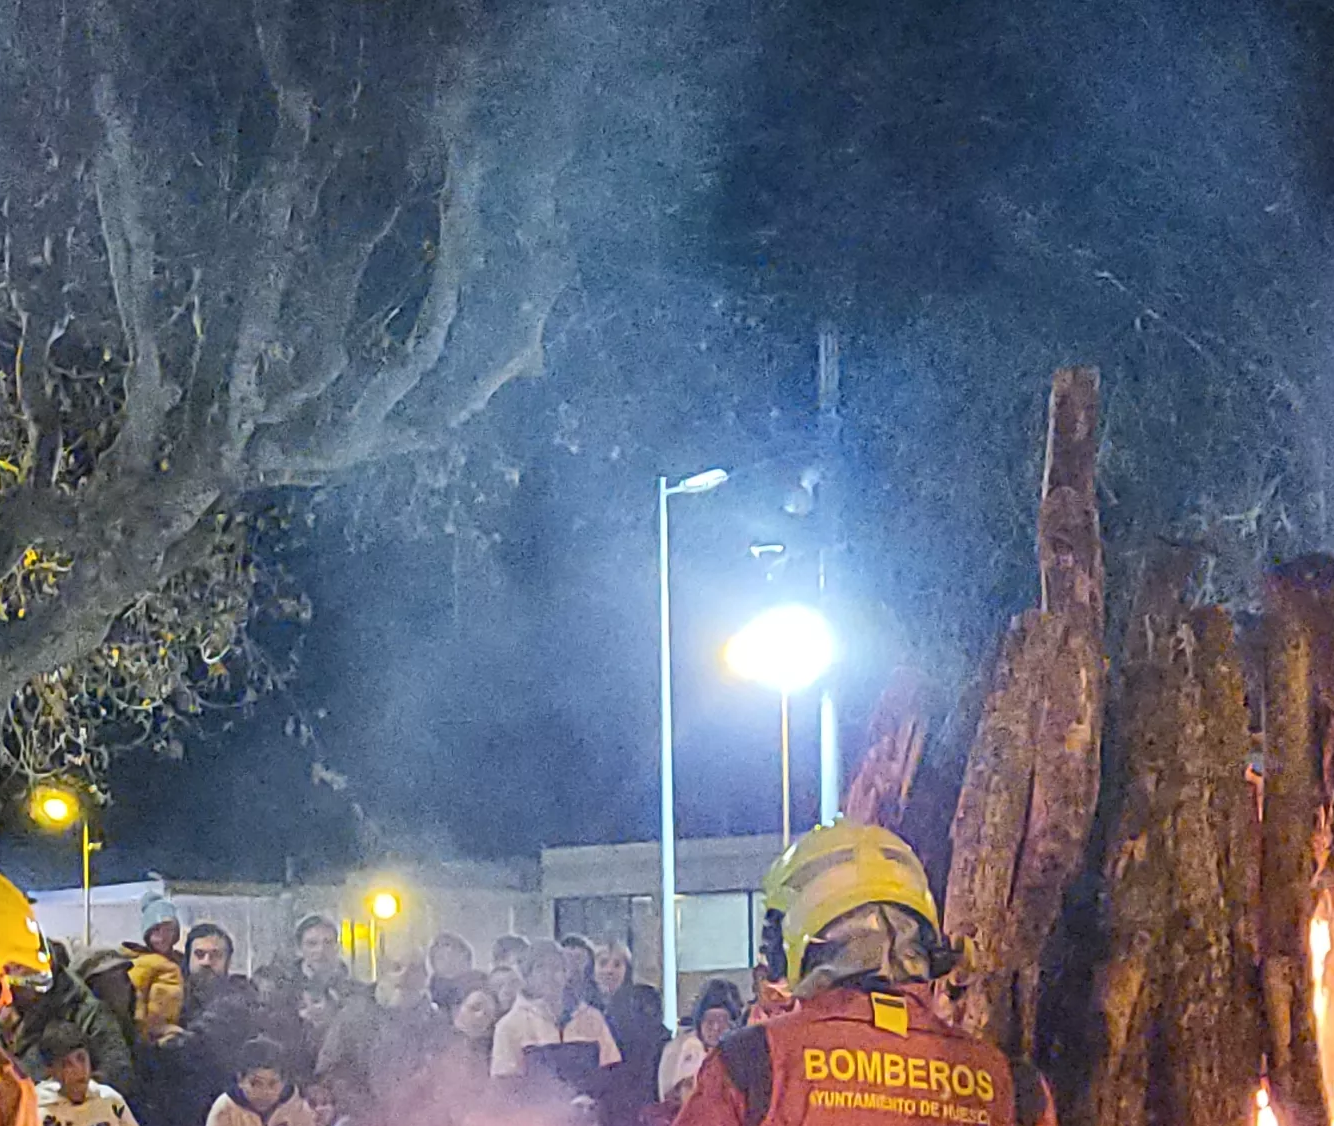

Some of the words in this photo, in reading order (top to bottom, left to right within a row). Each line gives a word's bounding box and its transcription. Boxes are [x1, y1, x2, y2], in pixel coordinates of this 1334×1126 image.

[803, 1048, 995, 1101] BOMBEROS
[920, 1100, 940, 1118] DE
[942, 1103, 991, 1126] HUESC
